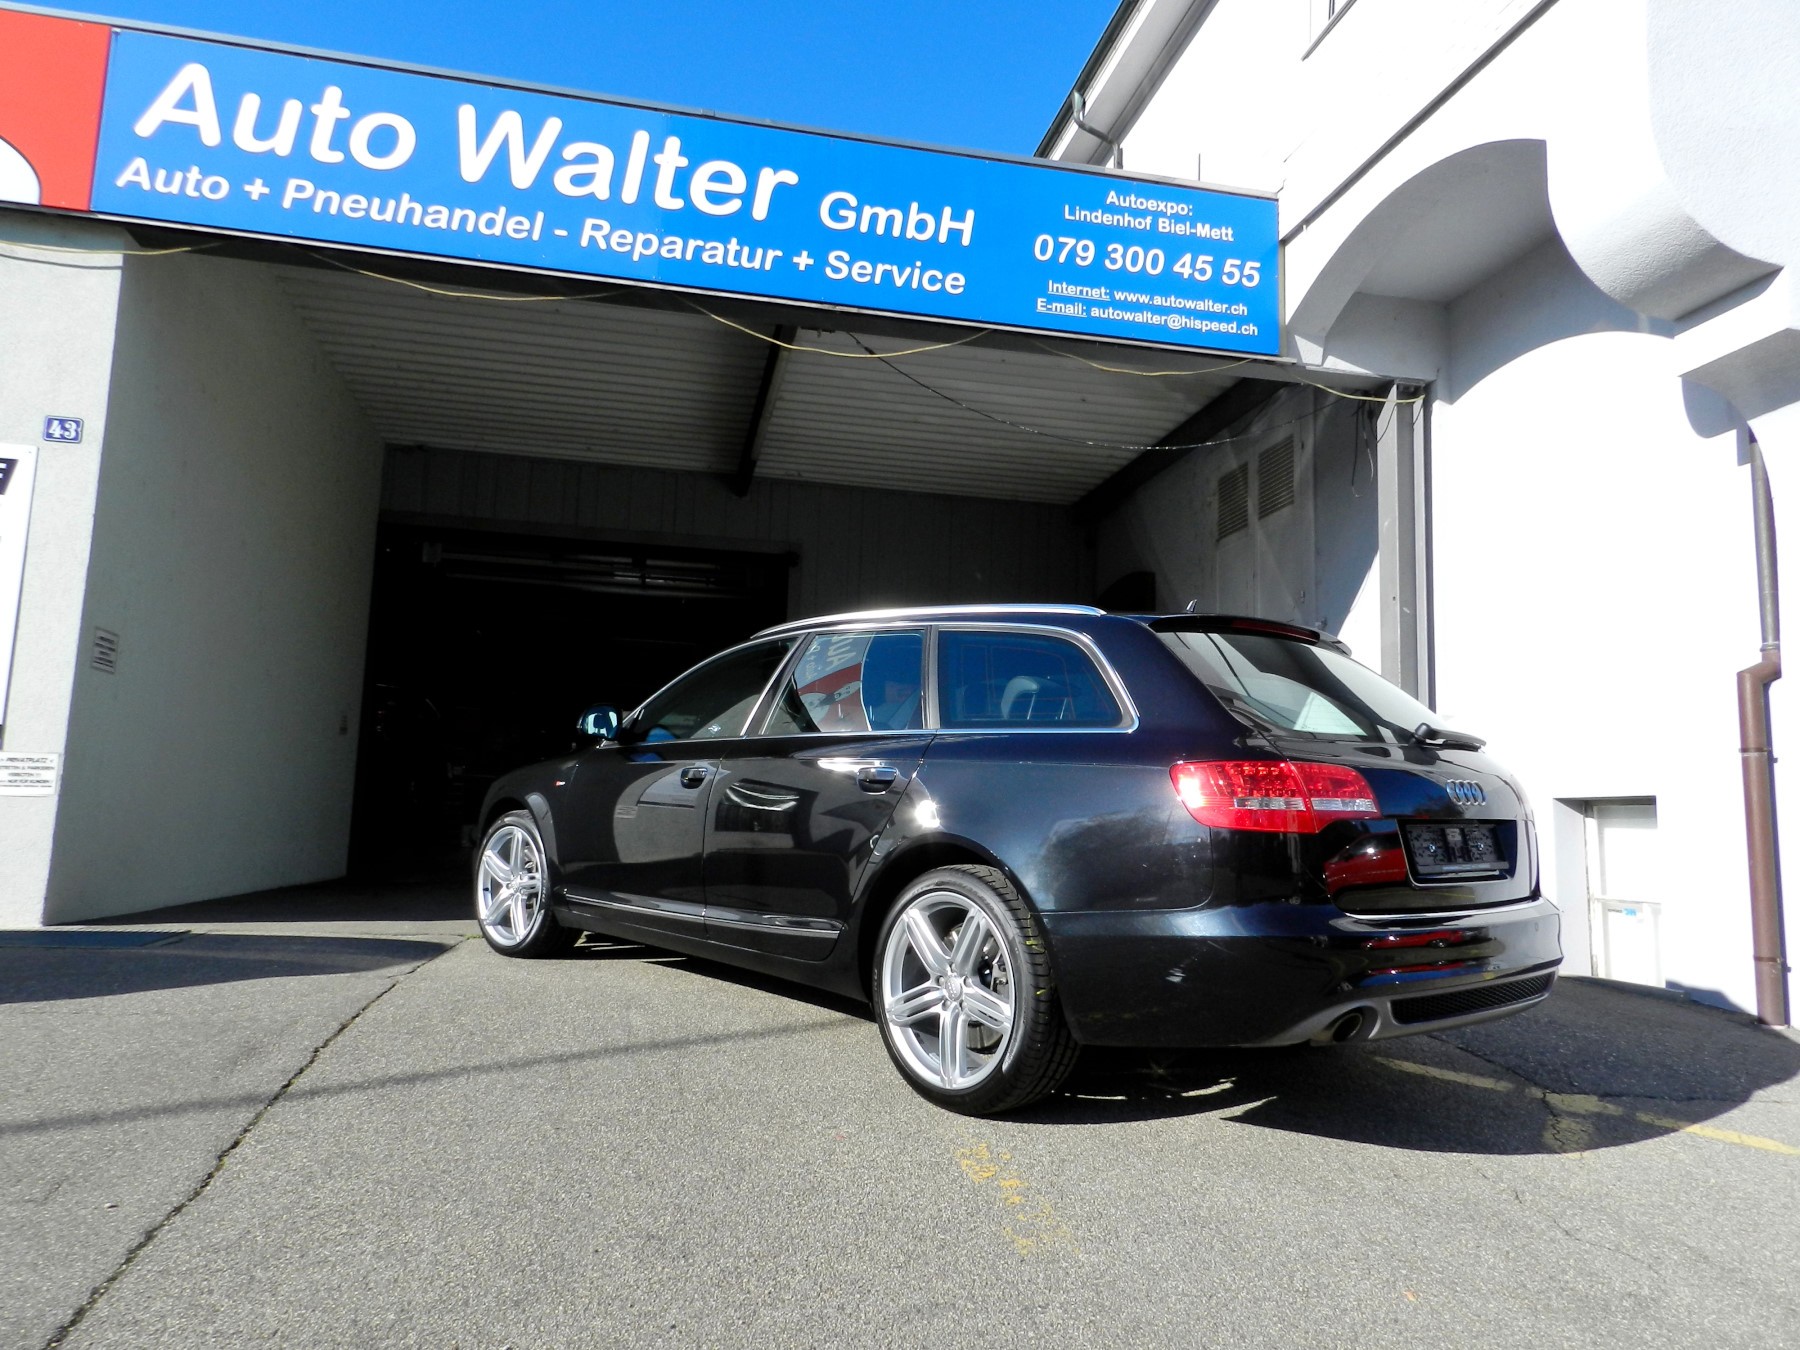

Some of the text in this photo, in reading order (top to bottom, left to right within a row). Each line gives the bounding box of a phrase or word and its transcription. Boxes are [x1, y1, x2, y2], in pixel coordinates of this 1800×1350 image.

[132, 62, 975, 247] Auto Walter GmbH
[1106, 190, 1193, 217] Autoexpo:
[115, 156, 966, 295] Auto + Pneuhandel - Reparatur + Service
[1064, 204, 1234, 242] Lindenhof Biel-Mett
[1034, 234, 1261, 288] 079 300 45 55
[1036, 297, 1258, 336] E-mail: autowalter@hispeed.ch
[1047, 280, 1248, 317] Internet: www.autowalter.ch
[48, 419, 78, 440] 43
